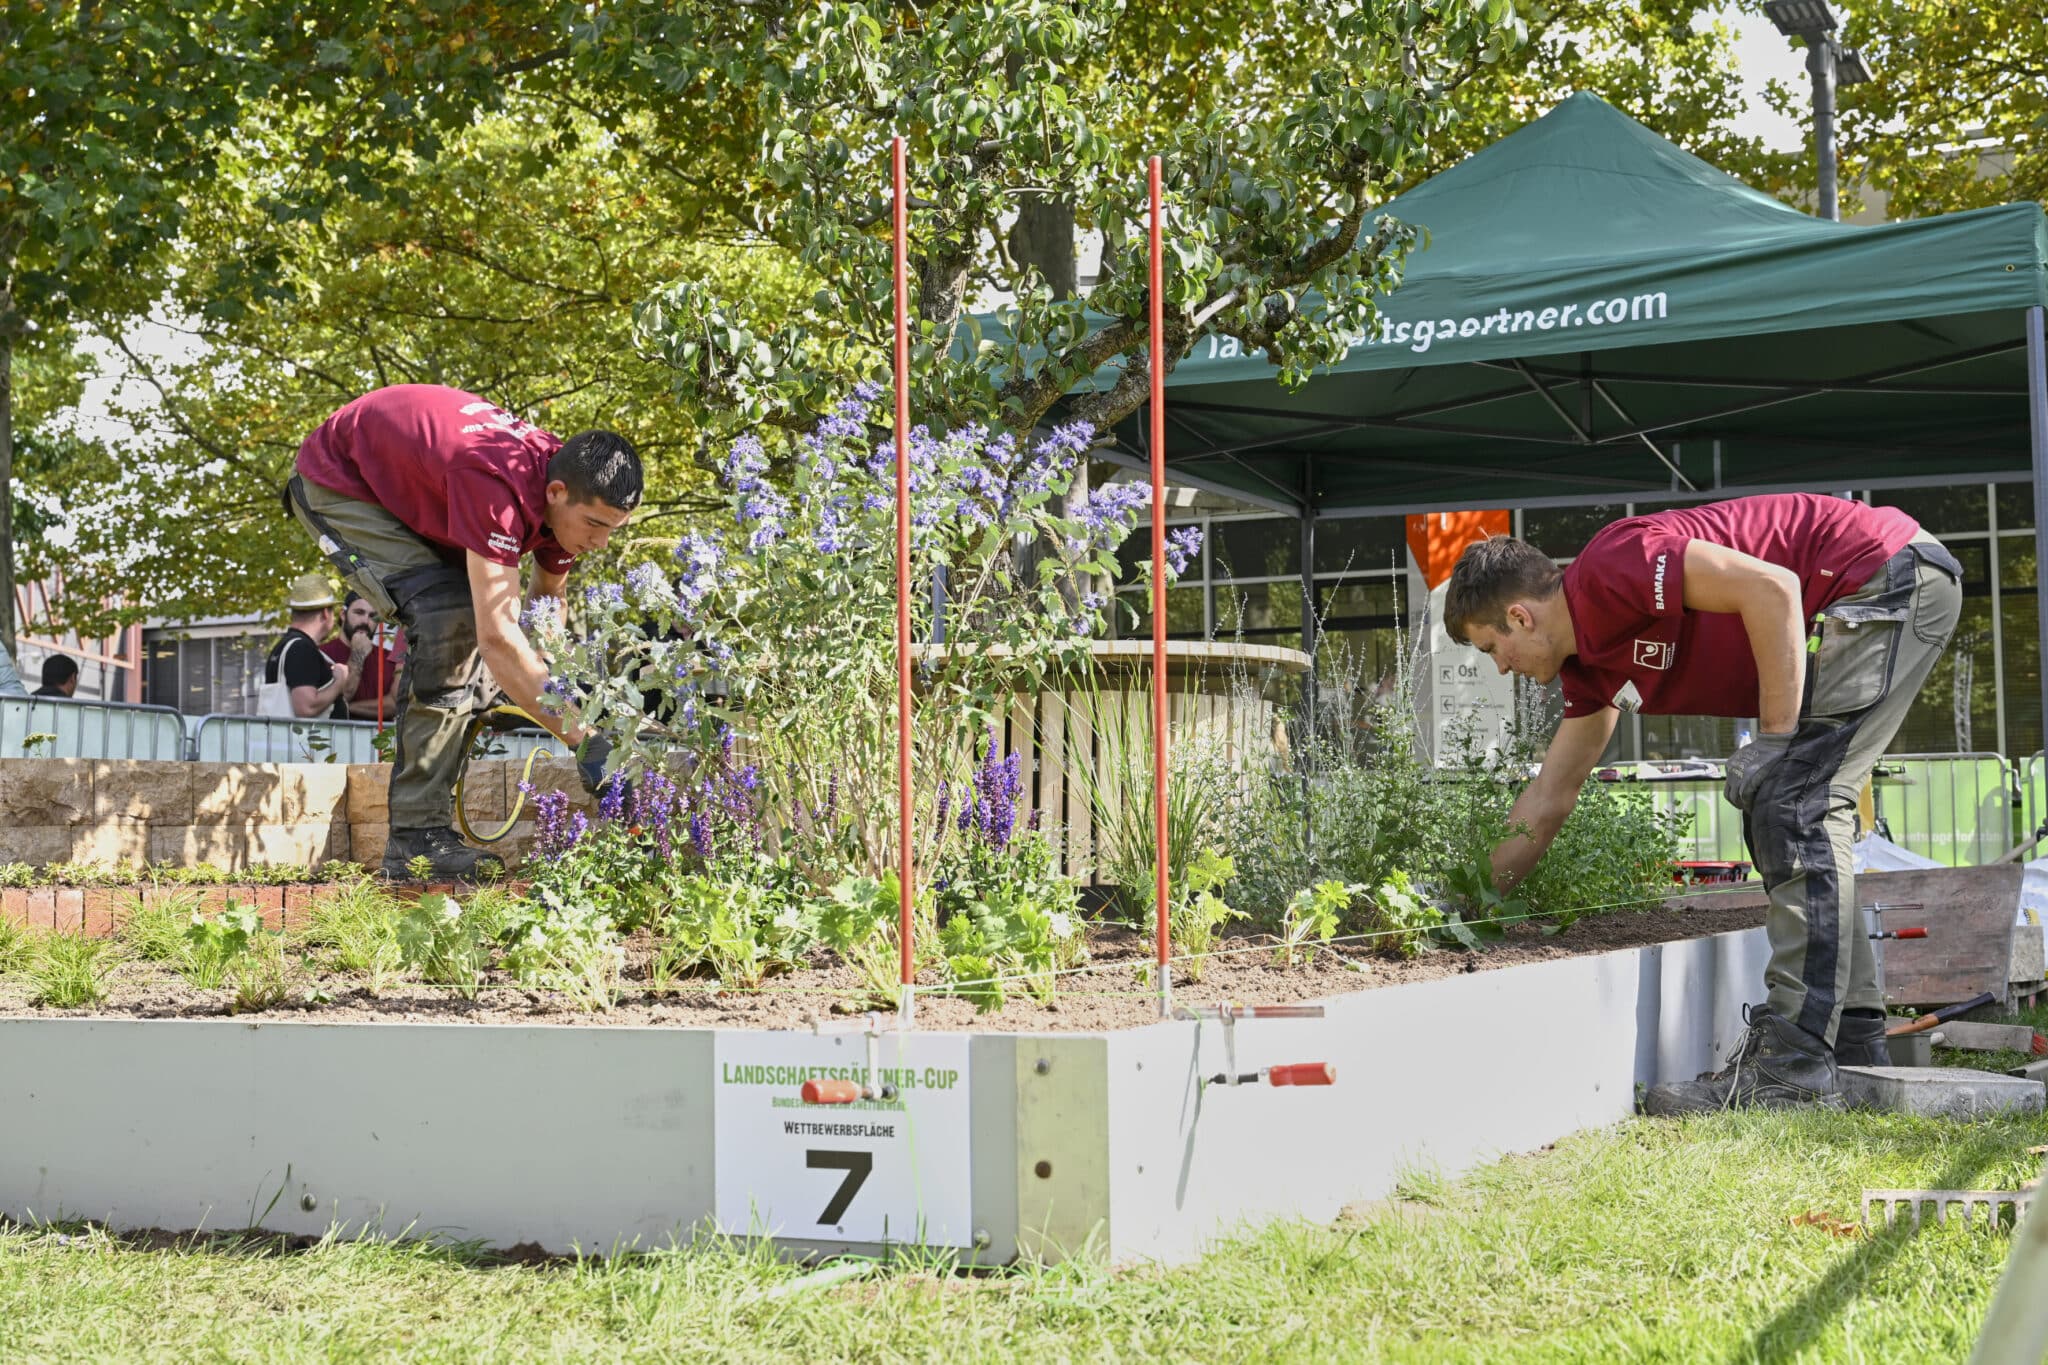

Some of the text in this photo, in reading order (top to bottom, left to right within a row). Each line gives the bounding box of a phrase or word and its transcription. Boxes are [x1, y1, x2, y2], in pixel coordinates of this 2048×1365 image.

[1208, 291, 1668, 360] latsgaertner.com
[1654, 554, 1667, 610] BAMAKA
[1458, 664, 1478, 677] Ost
[784, 1120, 895, 1138] WETTBEWERBSFLÄCHE
[805, 1149, 873, 1225] 7
